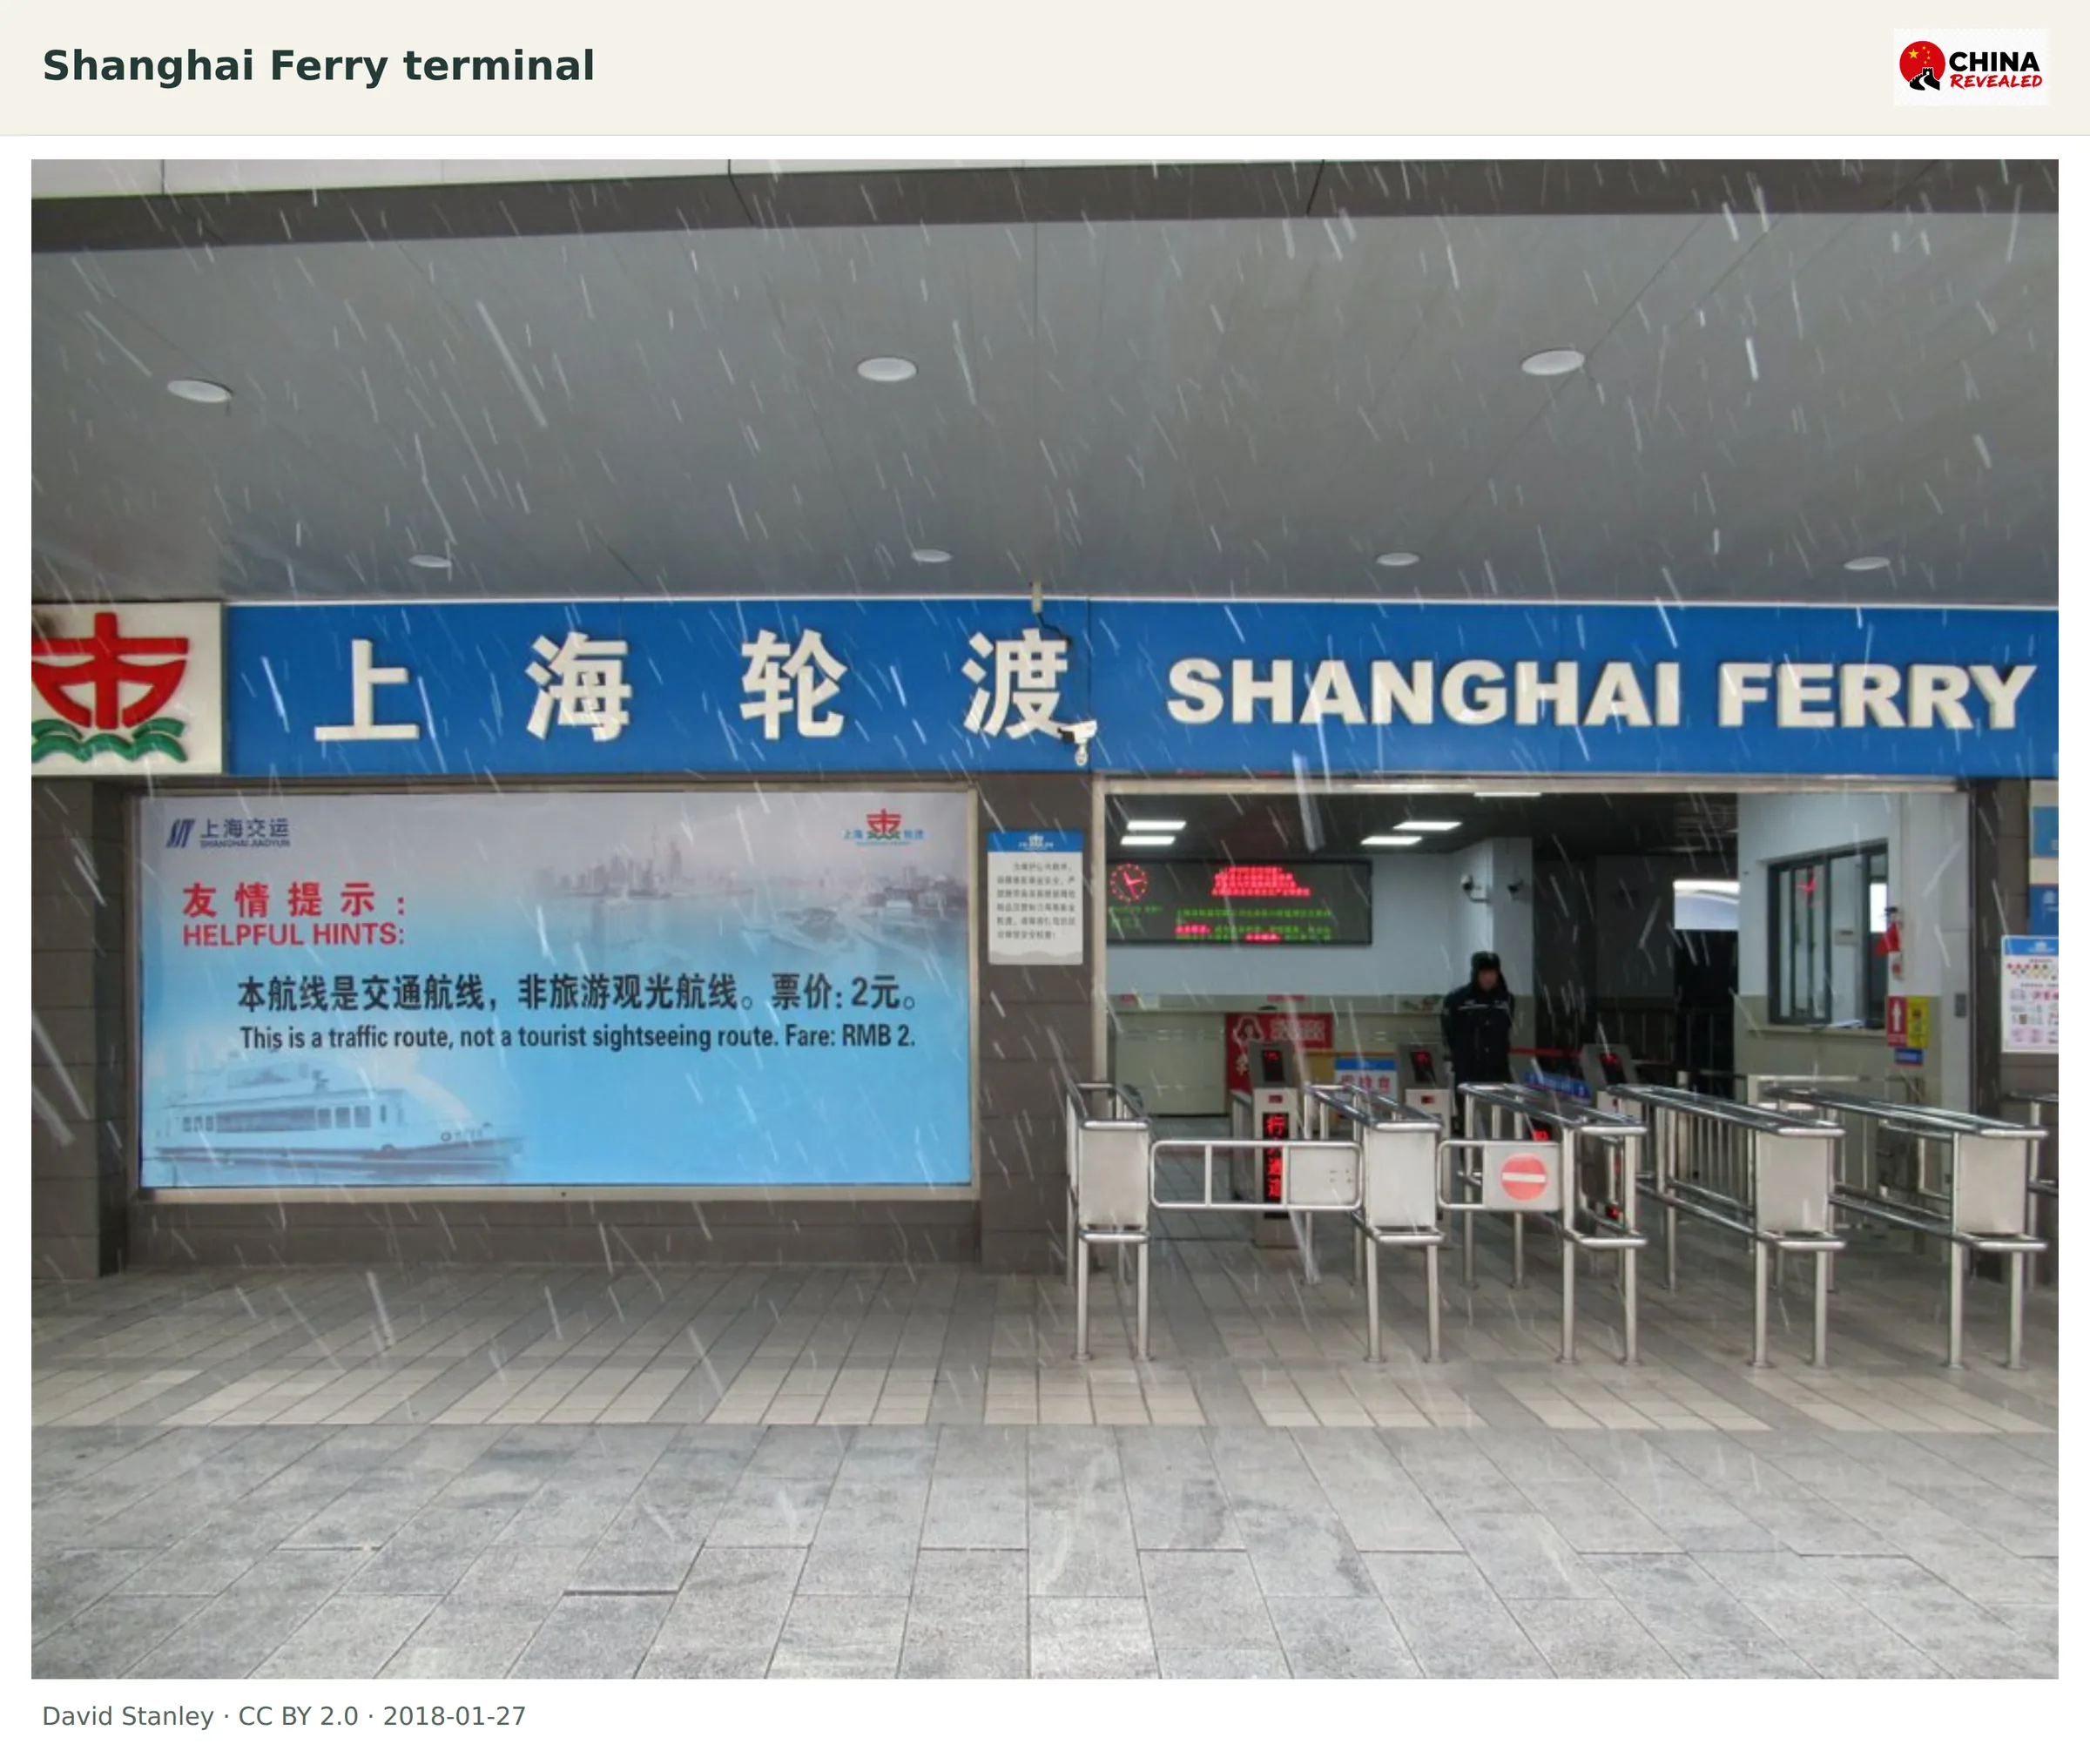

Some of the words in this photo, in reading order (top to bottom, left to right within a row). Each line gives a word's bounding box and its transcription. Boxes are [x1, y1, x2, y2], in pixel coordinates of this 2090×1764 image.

[314, 630, 1073, 744] 上海轮渡
[1167, 659, 1680, 728] SHANGHAI
[1719, 663, 2036, 731] FERRY
[200, 818, 289, 838] 上海交运
[183, 923, 303, 946] HELPFUL
[313, 923, 404, 946] HINTS:
[240, 1027, 282, 1049] This
[289, 1026, 305, 1048] is
[312, 1032, 322, 1048] a
[328, 1025, 388, 1048] traffic
[394, 1027, 453, 1050] route,
[461, 1027, 494, 1047] not
[501, 1030, 512, 1047] a
[518, 1024, 587, 1047] tourist
[593, 1023, 711, 1053] sightseeing
[718, 1027, 779, 1047] route.
[785, 1024, 835, 1047] Fare:
[842, 1024, 892, 1047] RMB
[897, 1024, 915, 1047] 2.
